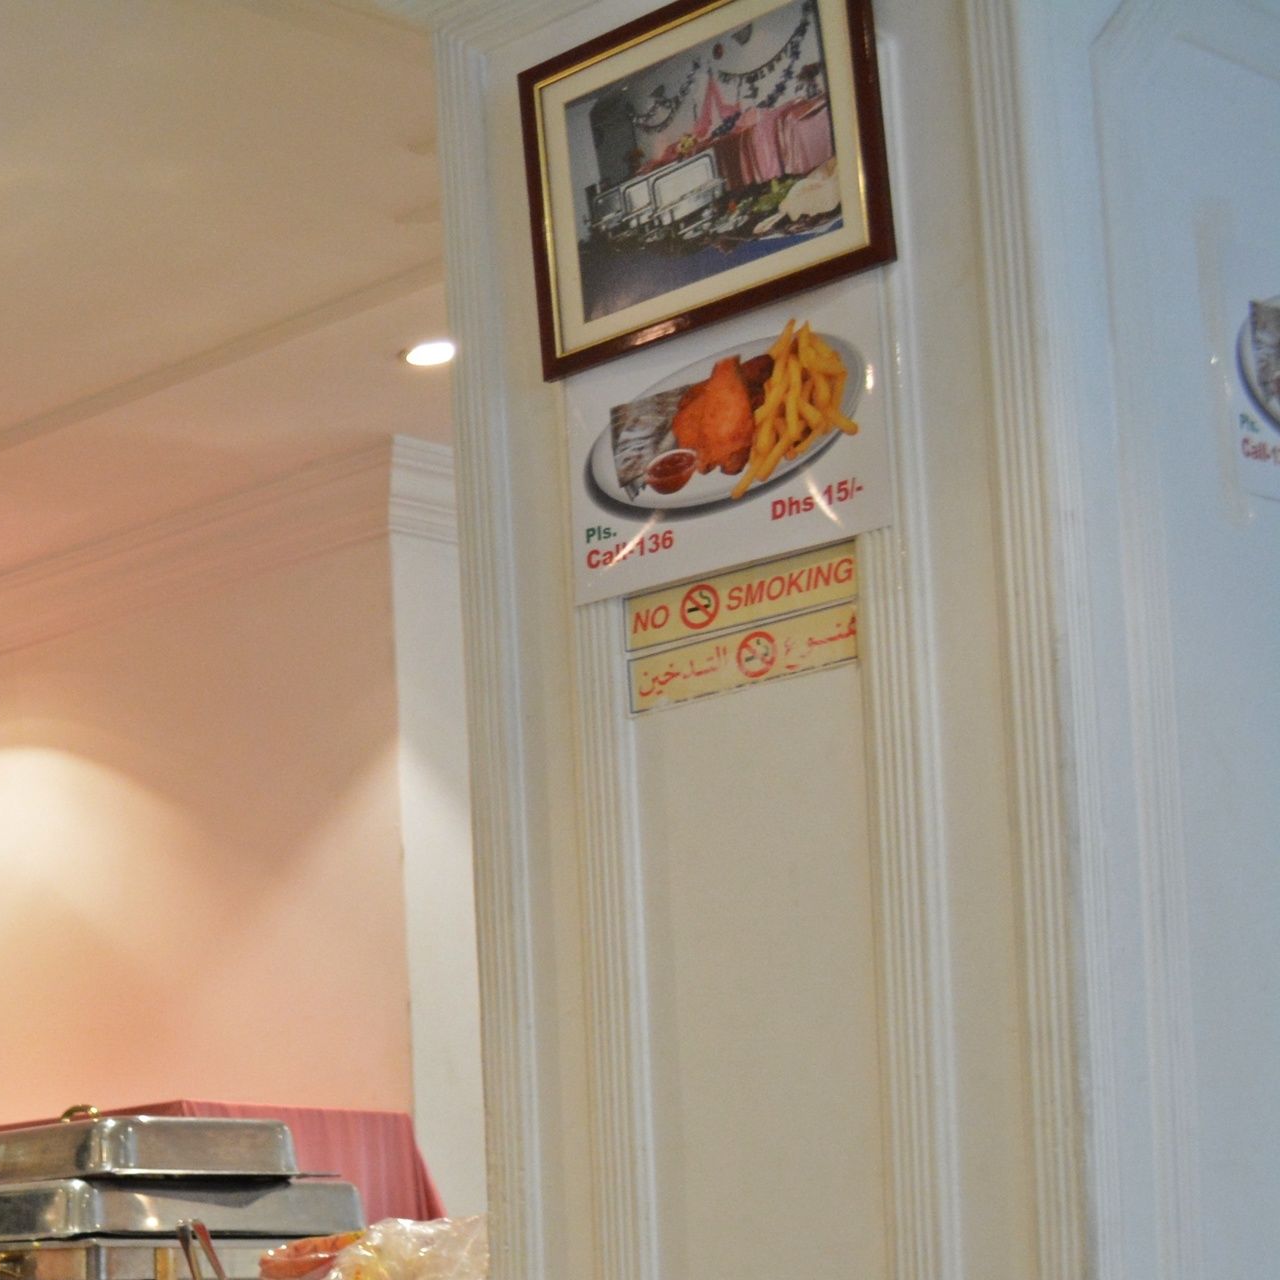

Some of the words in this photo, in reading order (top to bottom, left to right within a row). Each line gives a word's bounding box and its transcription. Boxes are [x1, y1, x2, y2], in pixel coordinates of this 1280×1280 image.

[771, 495, 816, 520] Dhs
[585, 526, 617, 543] Pls.
[632, 604, 670, 634] NO
[726, 557, 854, 611] SMOKING
